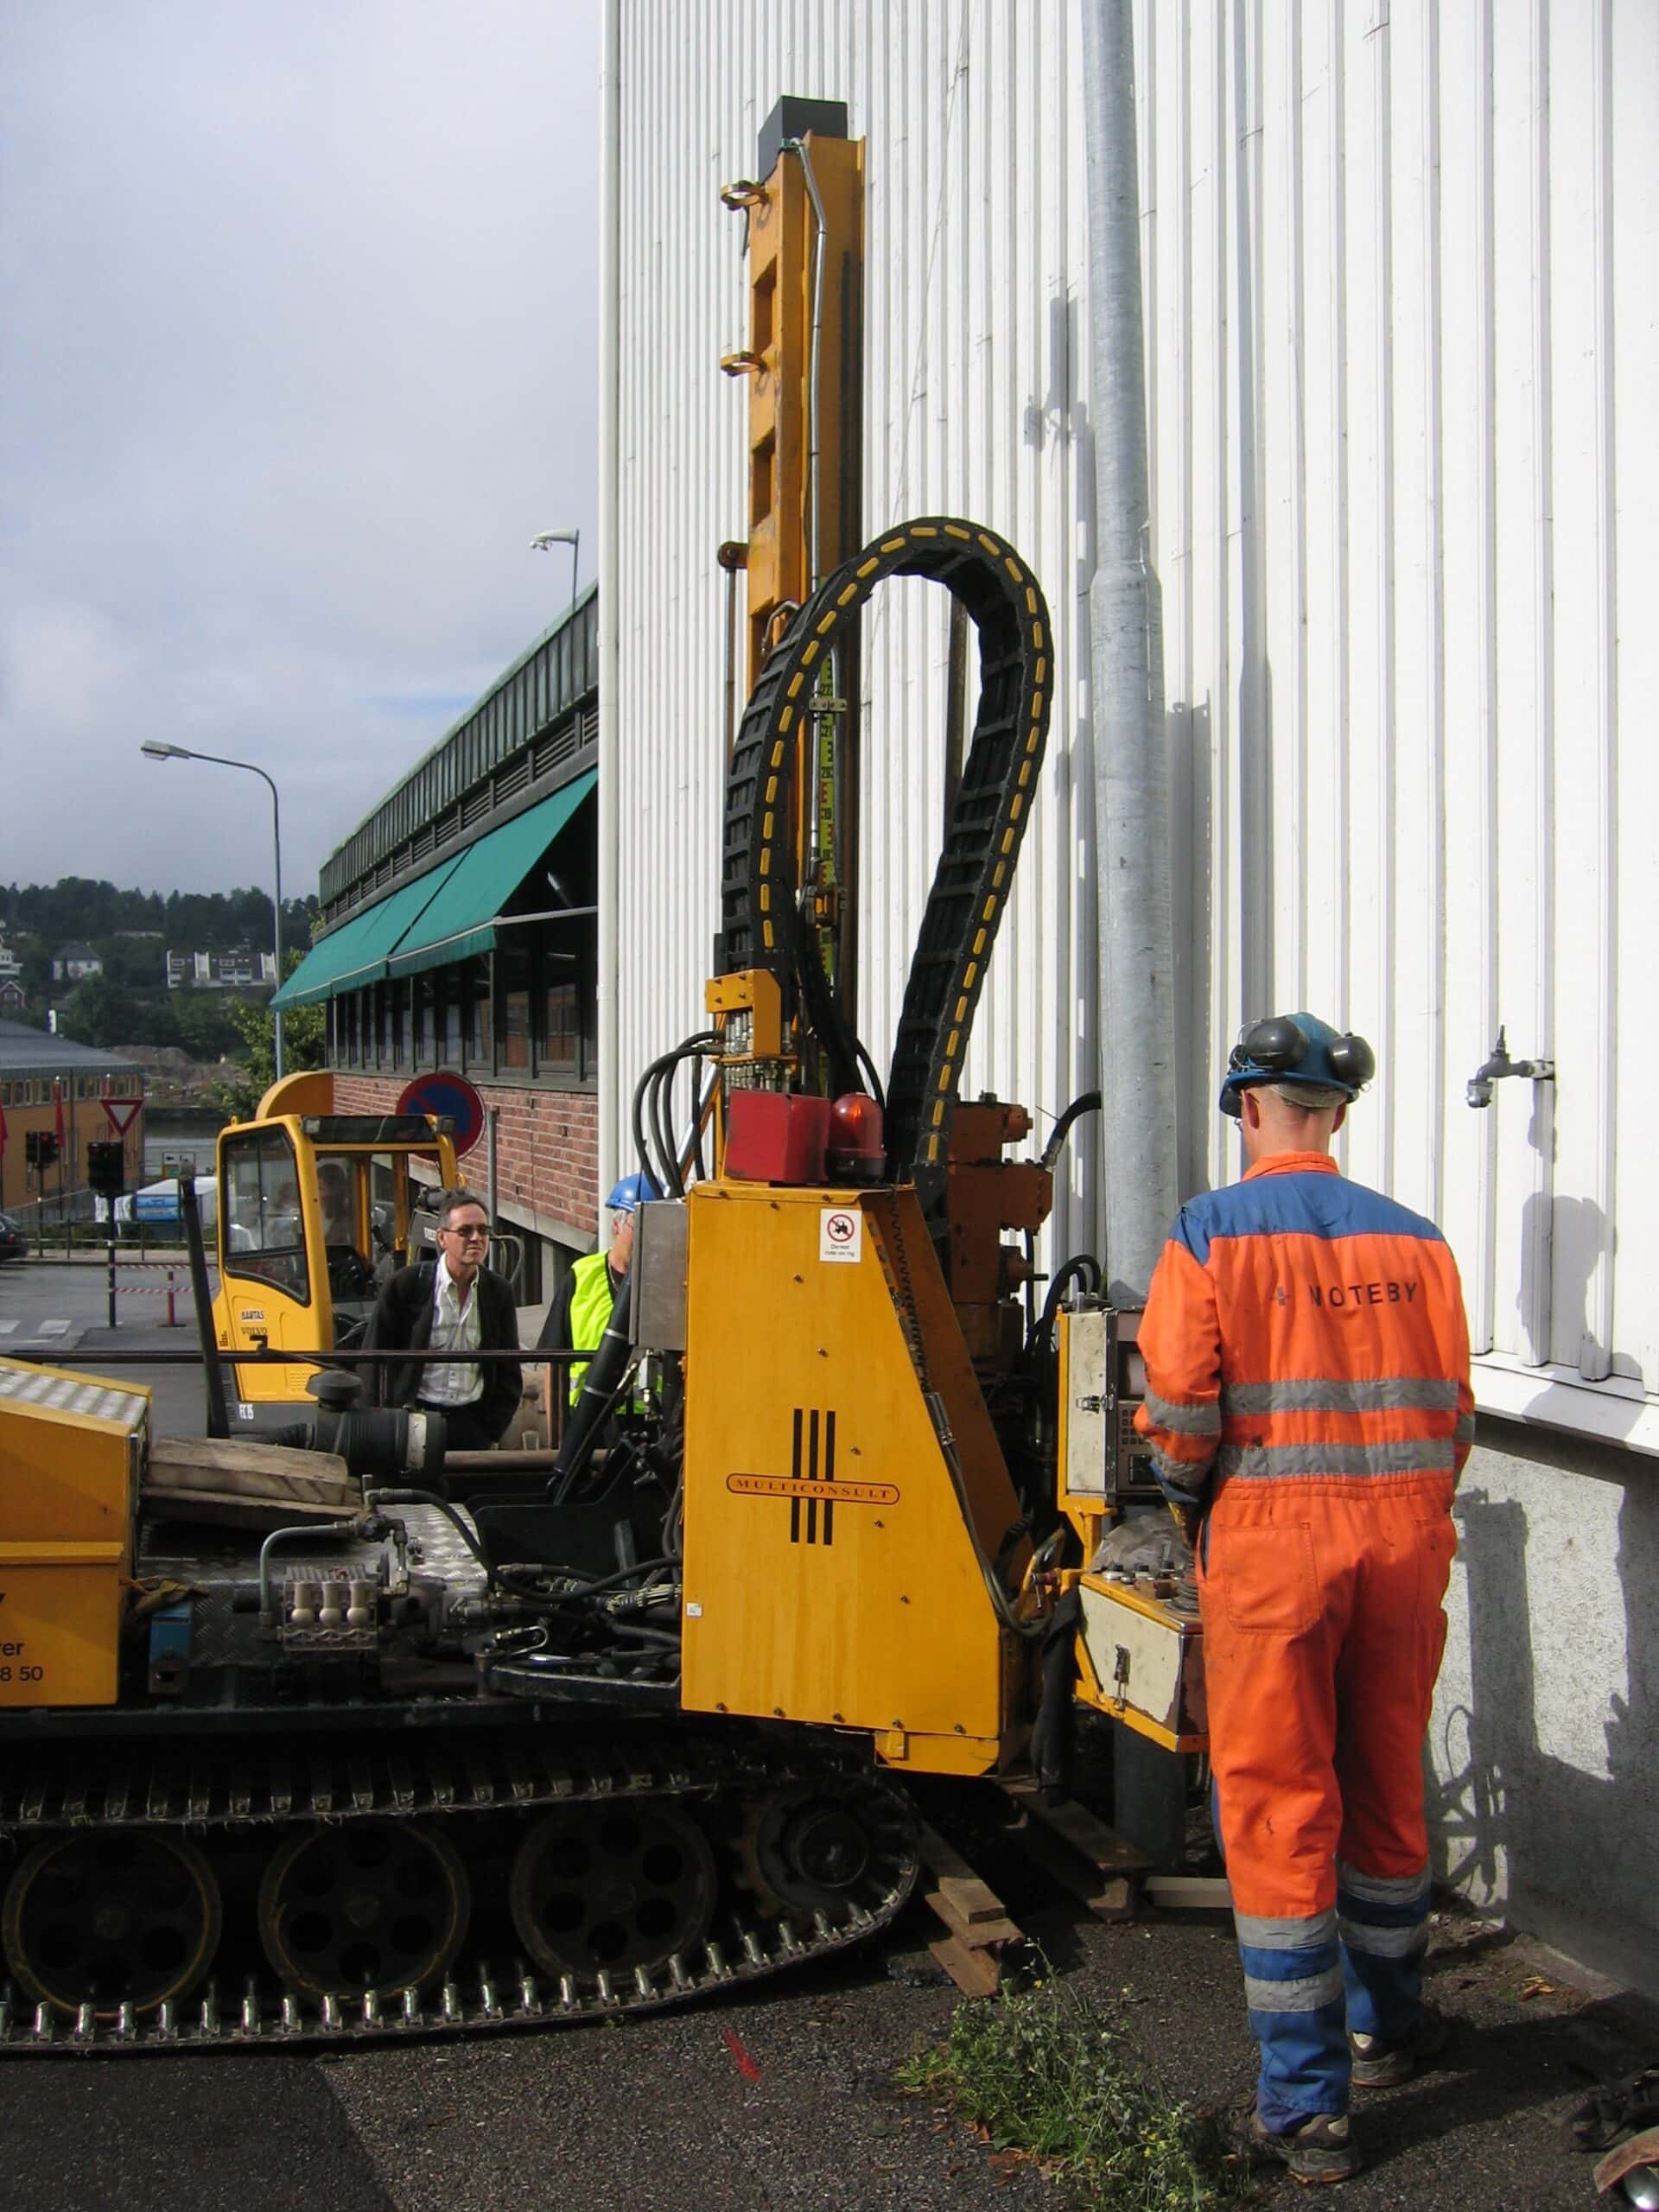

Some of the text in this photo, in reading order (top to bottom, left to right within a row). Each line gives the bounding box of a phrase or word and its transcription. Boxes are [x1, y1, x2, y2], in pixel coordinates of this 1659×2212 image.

[1309, 1282, 1418, 1308] NOTEBY
[736, 1478, 891, 1499] MULTICONSULT
[0, 1642, 25, 1656] er
[19, 1666, 44, 1682] 50
